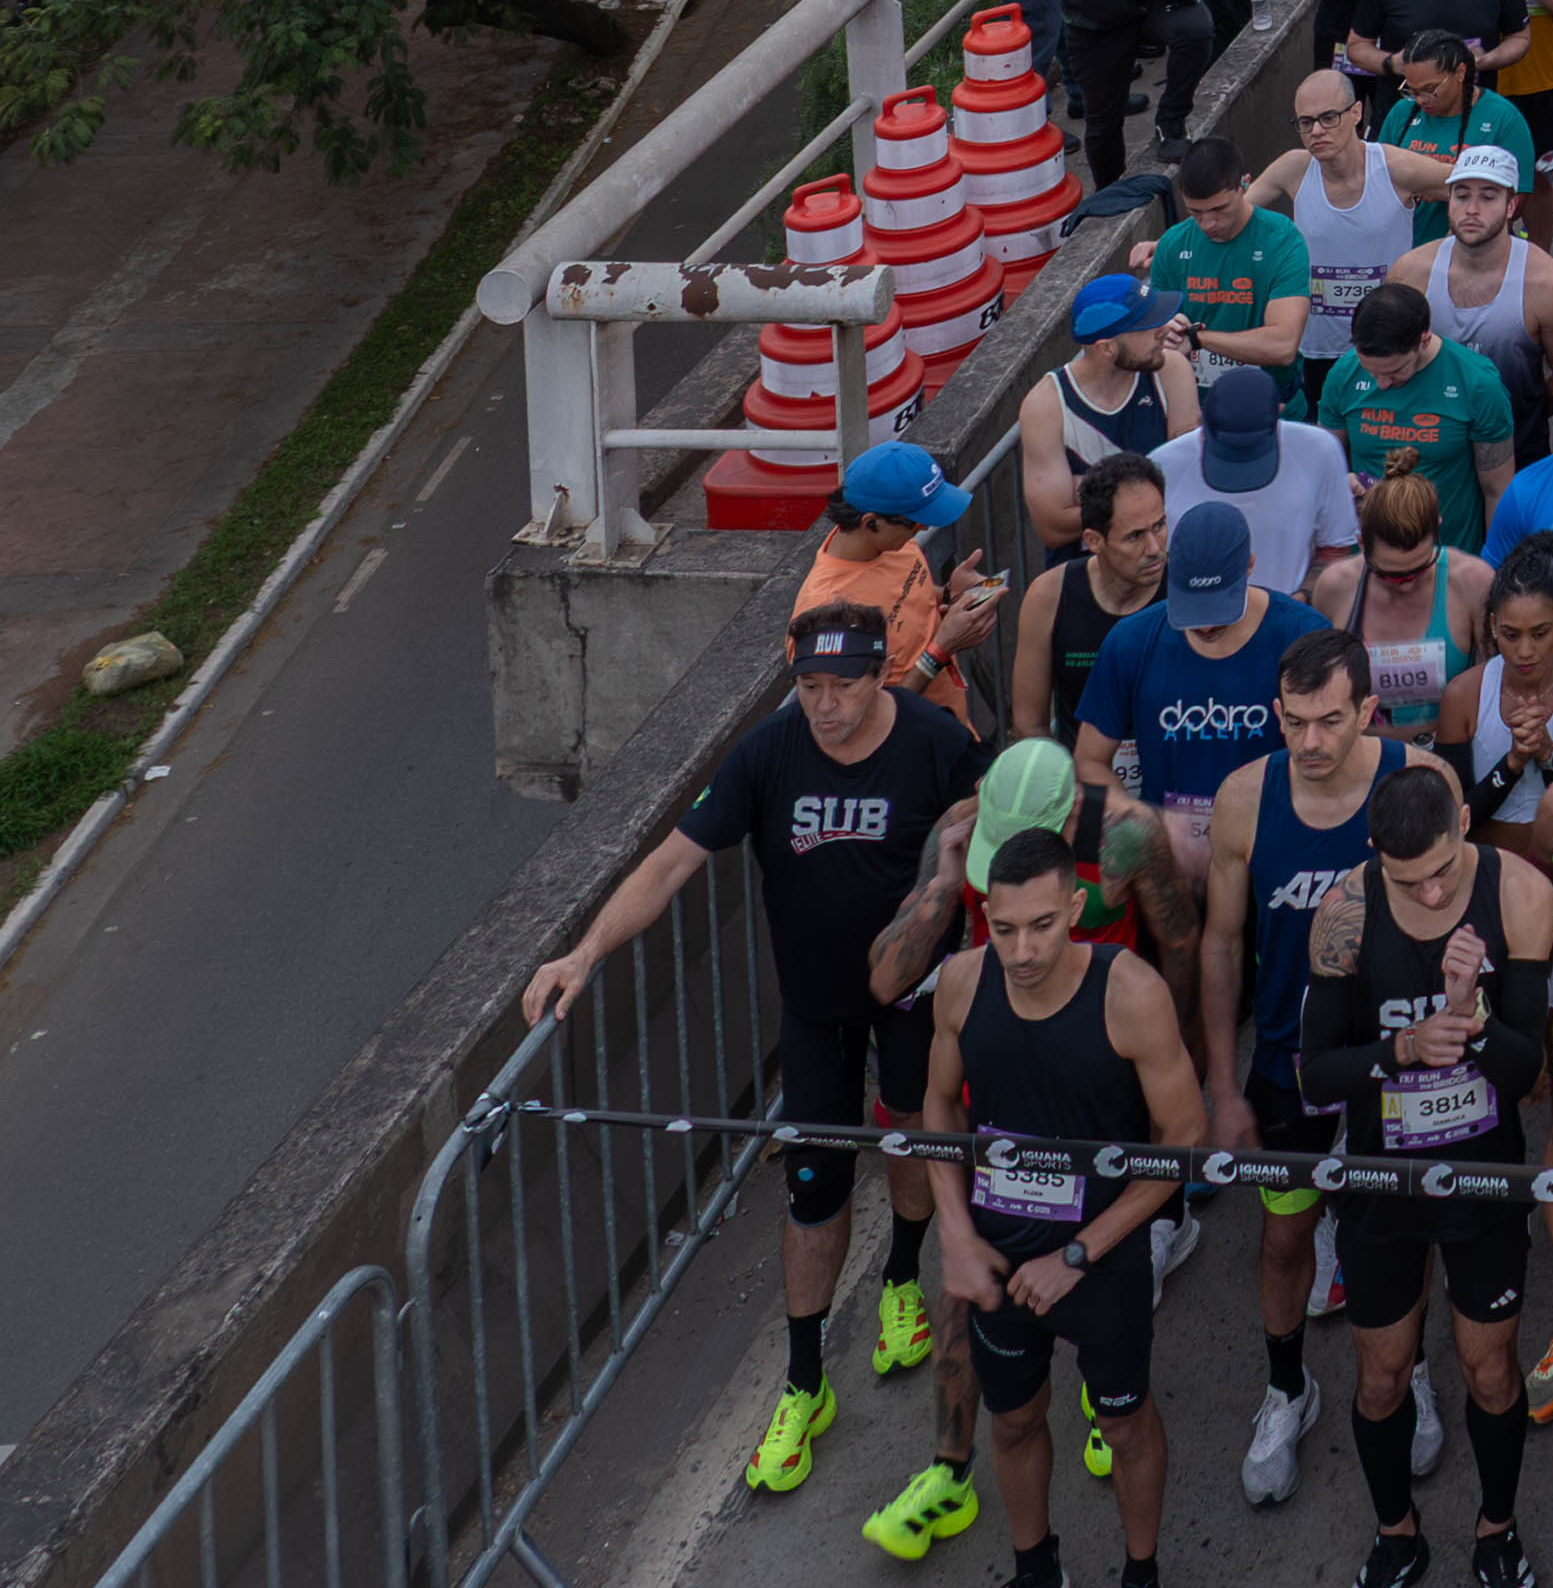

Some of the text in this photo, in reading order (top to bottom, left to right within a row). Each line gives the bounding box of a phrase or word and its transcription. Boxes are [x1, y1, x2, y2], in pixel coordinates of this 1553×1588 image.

[1187, 276, 1219, 290] RUN
[1207, 290, 1254, 305] BRIDGE
[1361, 408, 1395, 423] RUN
[1360, 423, 1440, 444] THE BRIDGE
[815, 633, 844, 655] RUN
[1379, 670, 1428, 690] 8109
[1160, 699, 1268, 731] dobro
[793, 795, 889, 837] SUB
[1418, 1071, 1441, 1082] RUN
[1433, 1073, 1470, 1090] BRIDGE
[1419, 1091, 1477, 1117] 3814
[1022, 1150, 1072, 1162] IGUANA
[1130, 1158, 1180, 1170] IGUANA
[1239, 1164, 1289, 1176] IGUANA
[1348, 1171, 1398, 1182] IGUANA
[1458, 1177, 1508, 1188] IGUANA
